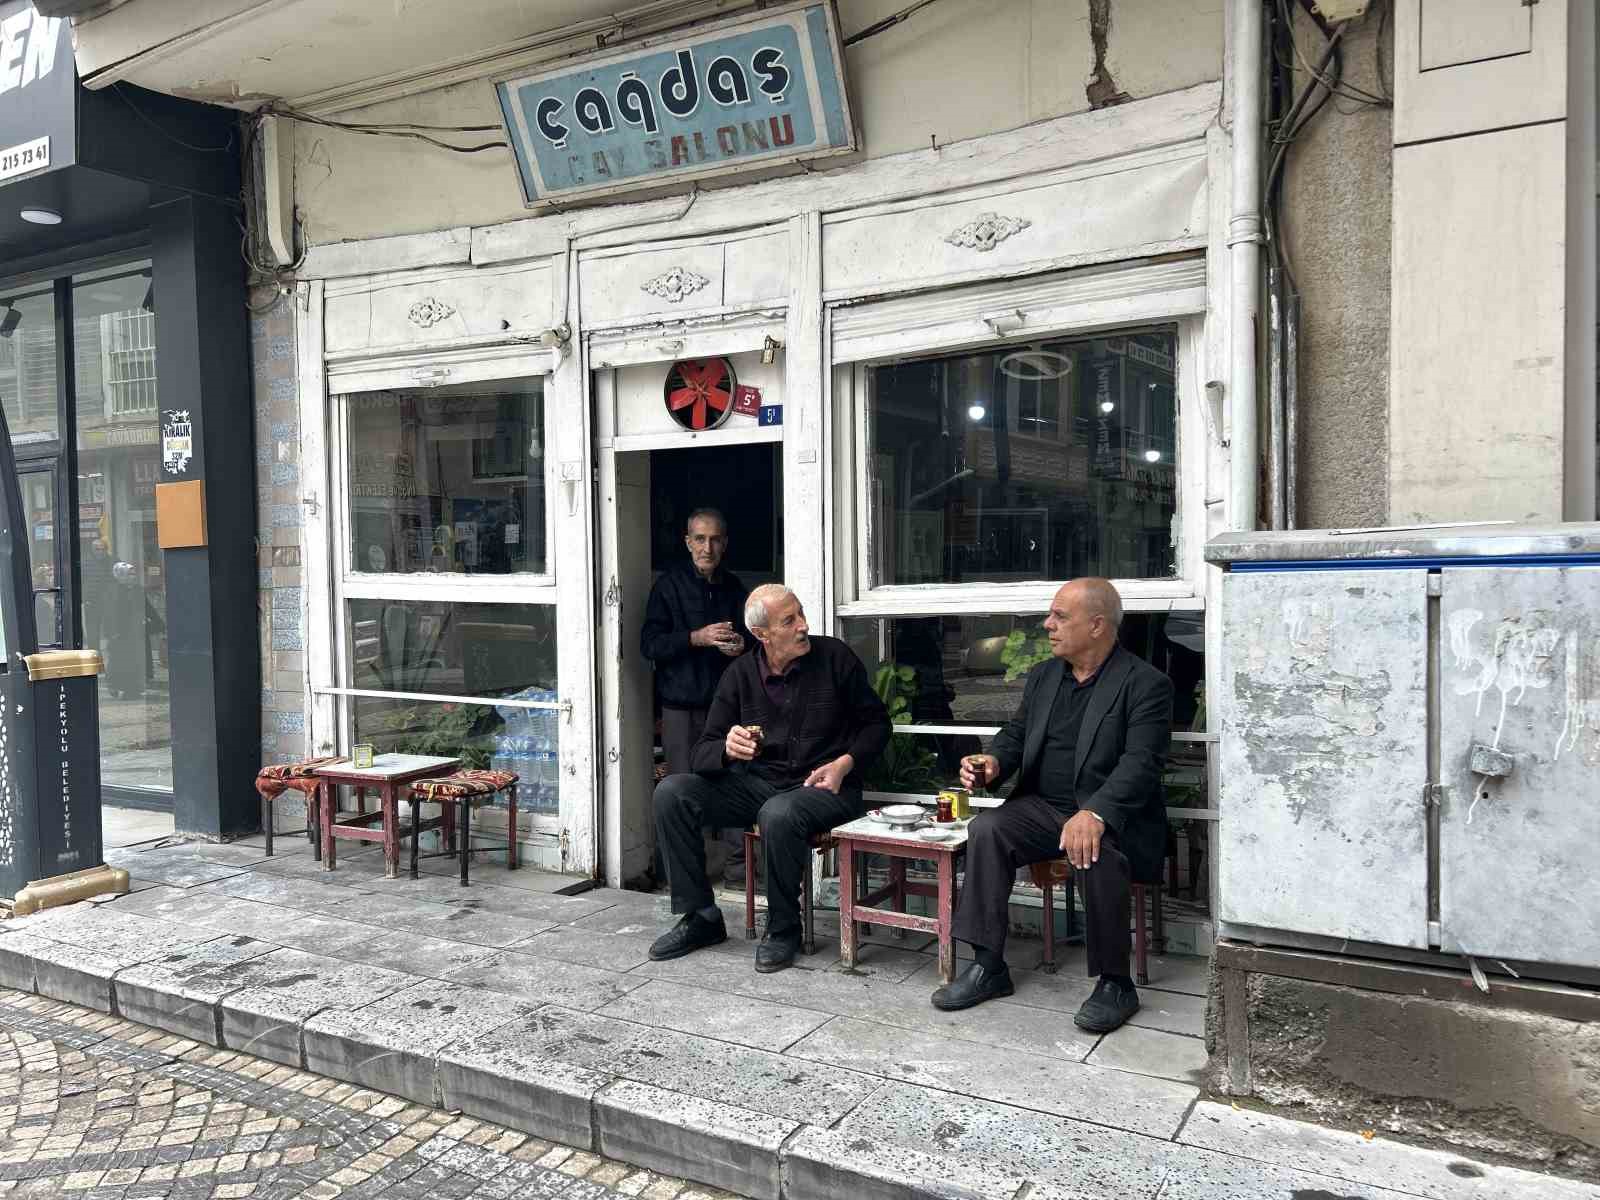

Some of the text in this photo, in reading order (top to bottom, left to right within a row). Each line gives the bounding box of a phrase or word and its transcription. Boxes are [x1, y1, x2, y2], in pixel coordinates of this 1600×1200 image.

[3, 144, 47, 171] 215 73 41
[644, 114, 794, 167] SALONU
